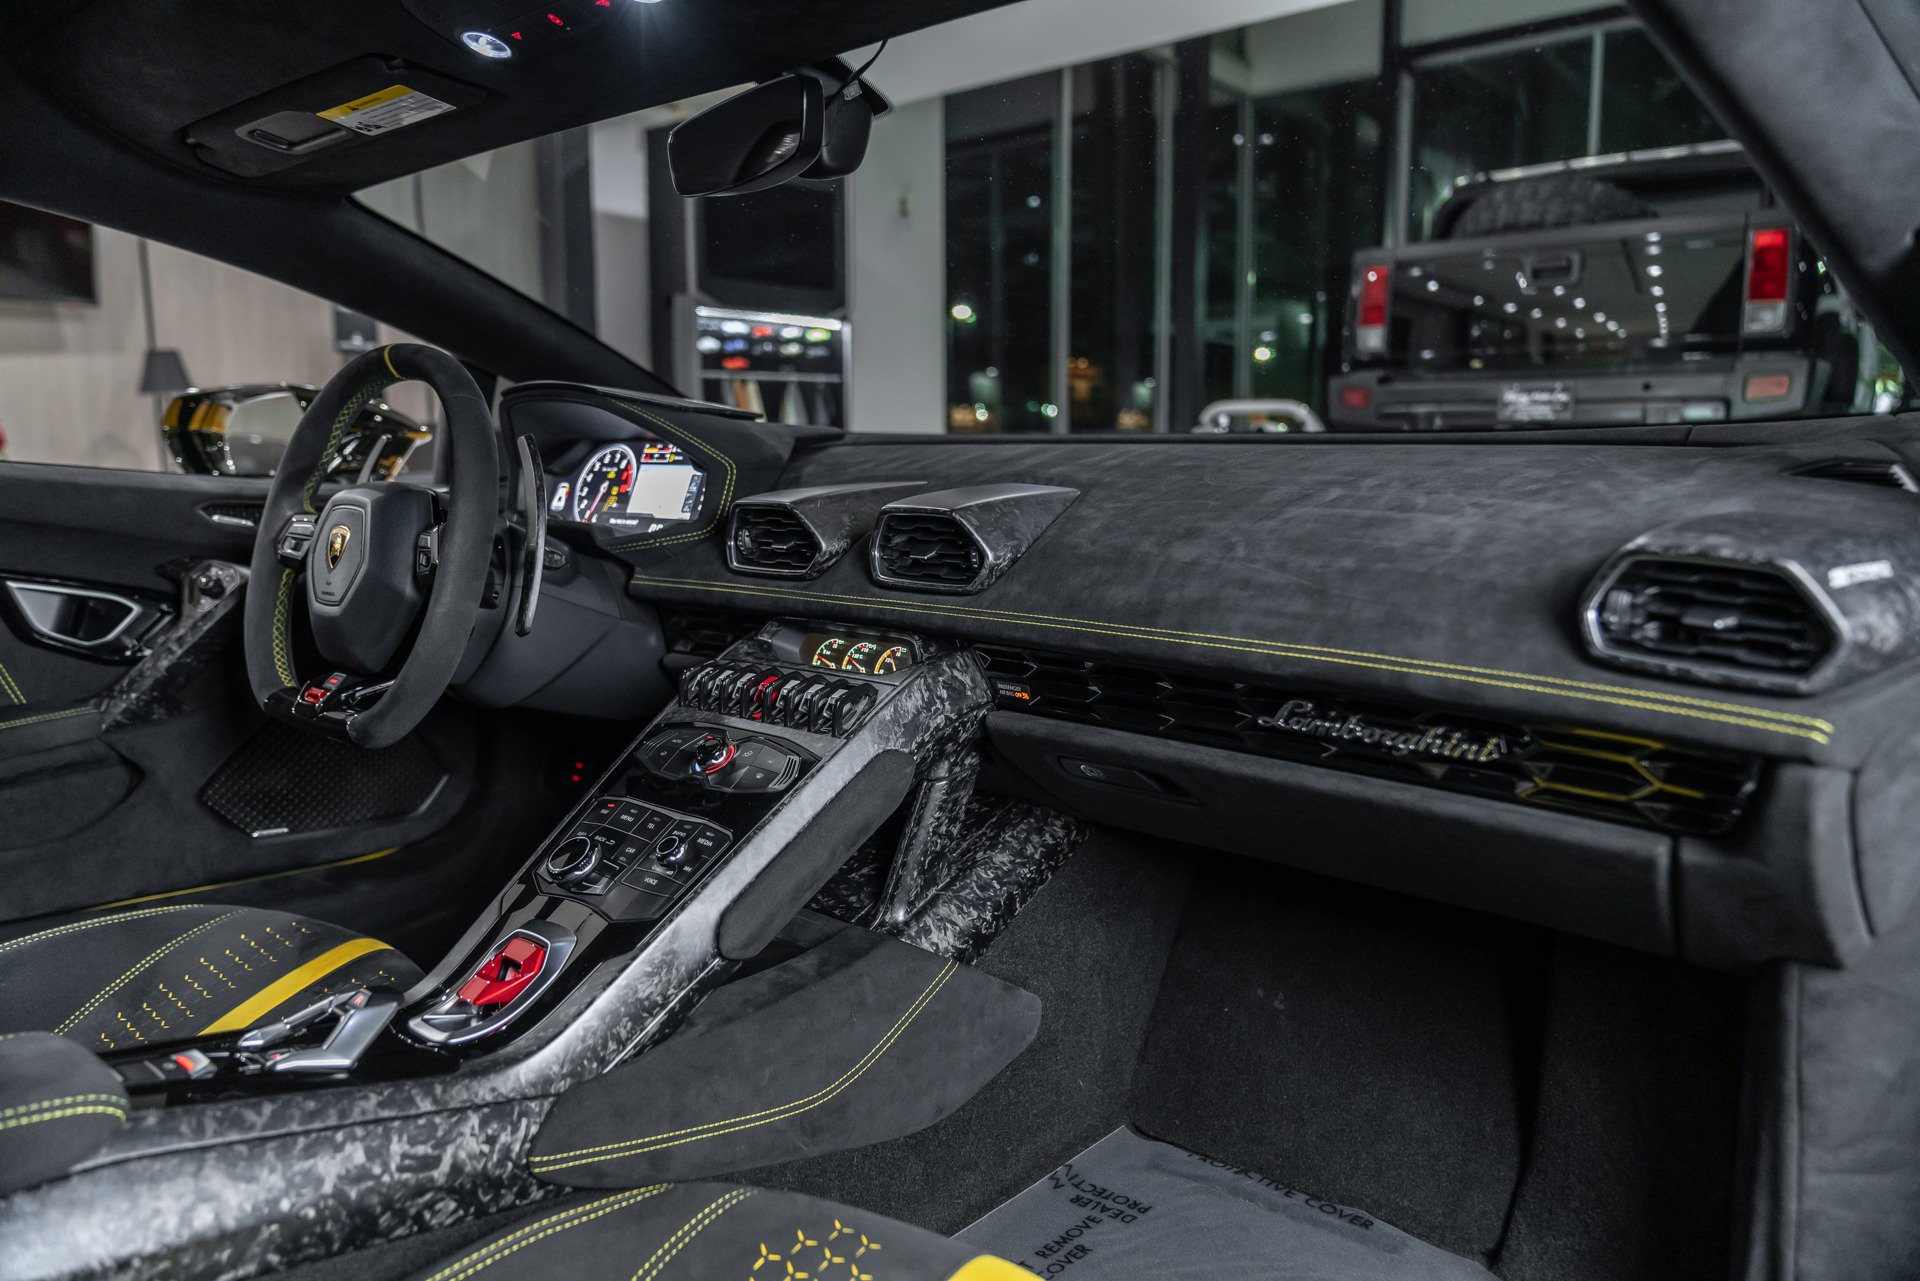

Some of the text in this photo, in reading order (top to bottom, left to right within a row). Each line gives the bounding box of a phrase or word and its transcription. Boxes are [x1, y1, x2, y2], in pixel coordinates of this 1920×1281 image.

[1257, 699, 1501, 762] Lamborghini
[620, 814, 635, 823] MENU
[697, 837, 714, 847] MEDIA
[644, 876, 659, 886] VOICE
[1069, 1194, 1138, 1224] DEALER
[1305, 1197, 1375, 1230] COVER
[1035, 1214, 1103, 1259] REMOVE
